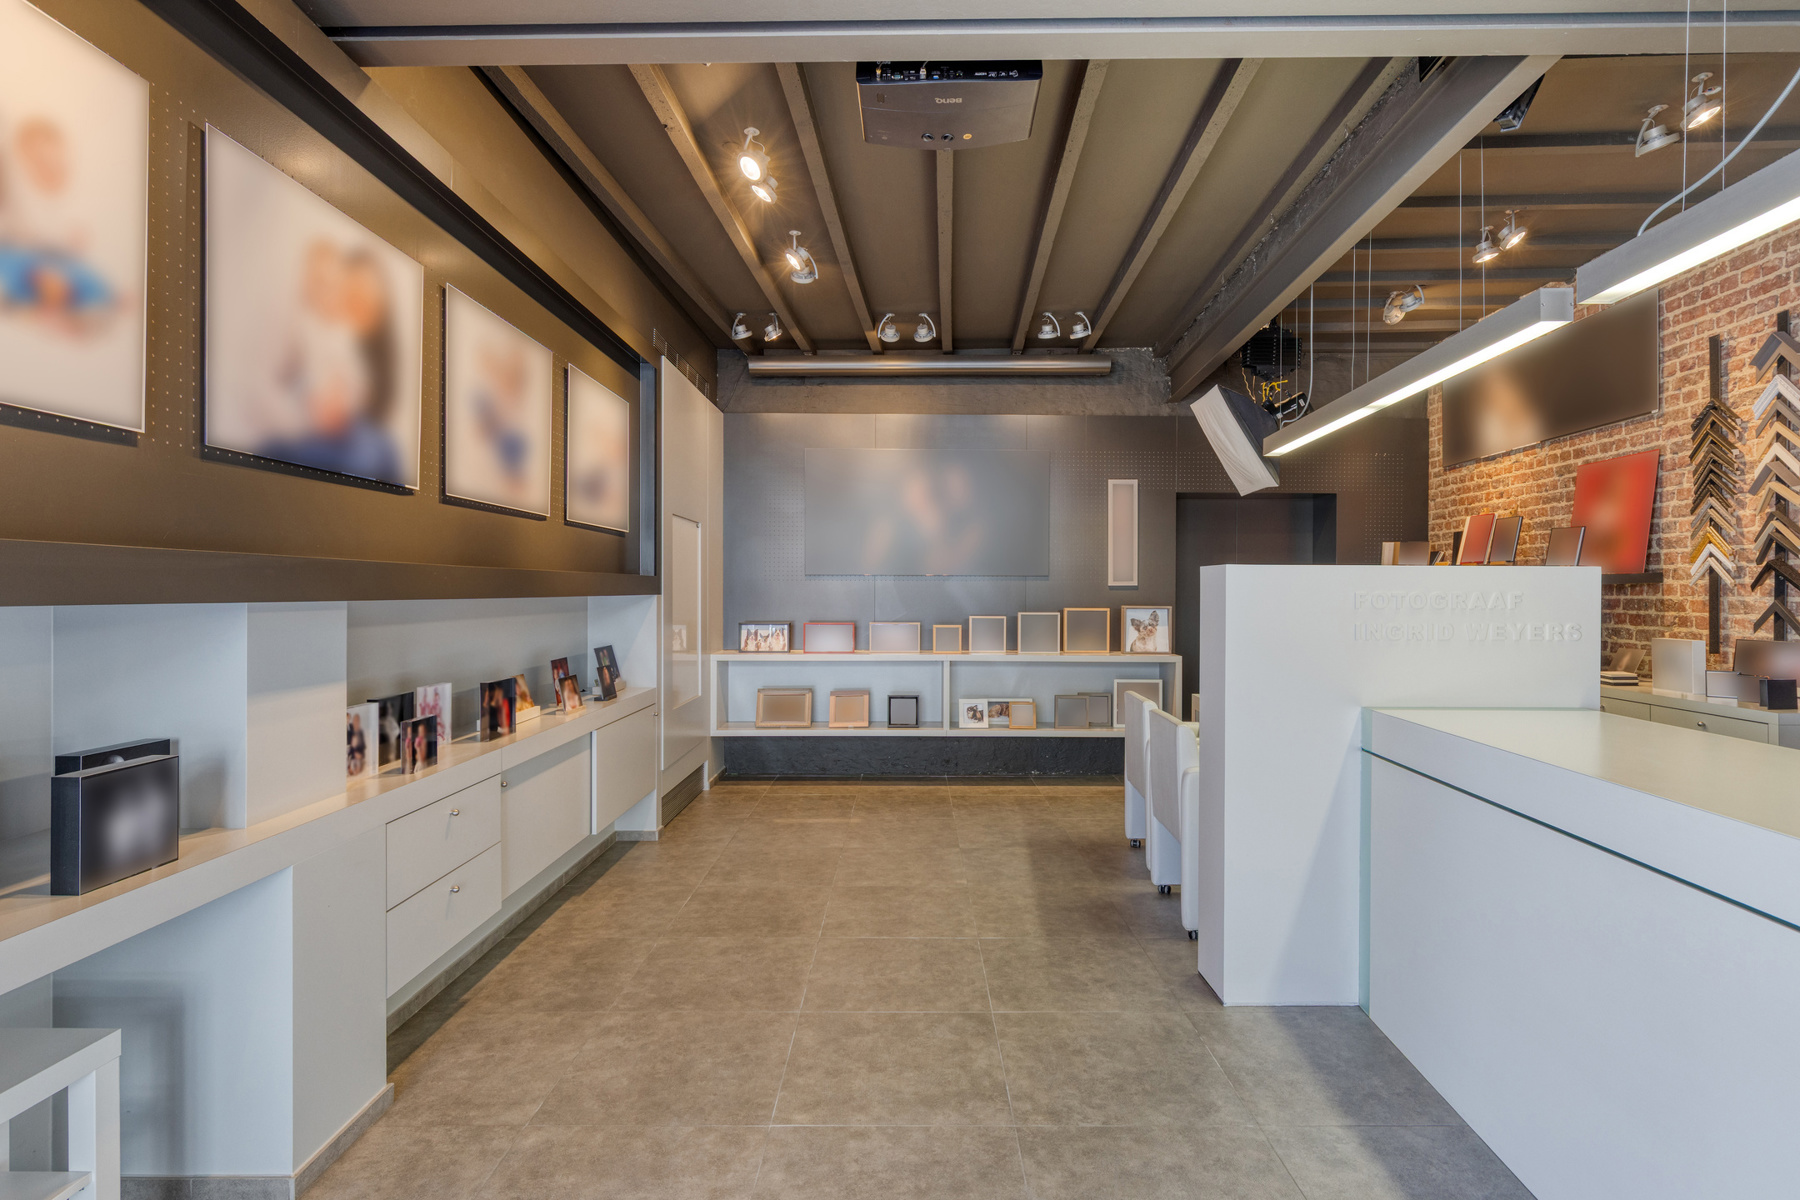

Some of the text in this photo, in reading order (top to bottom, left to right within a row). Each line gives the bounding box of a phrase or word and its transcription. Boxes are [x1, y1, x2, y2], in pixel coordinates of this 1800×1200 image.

[1353, 591, 1524, 611] FOTOGRAAF
[1353, 622, 1583, 642] INGRID WEYERS
